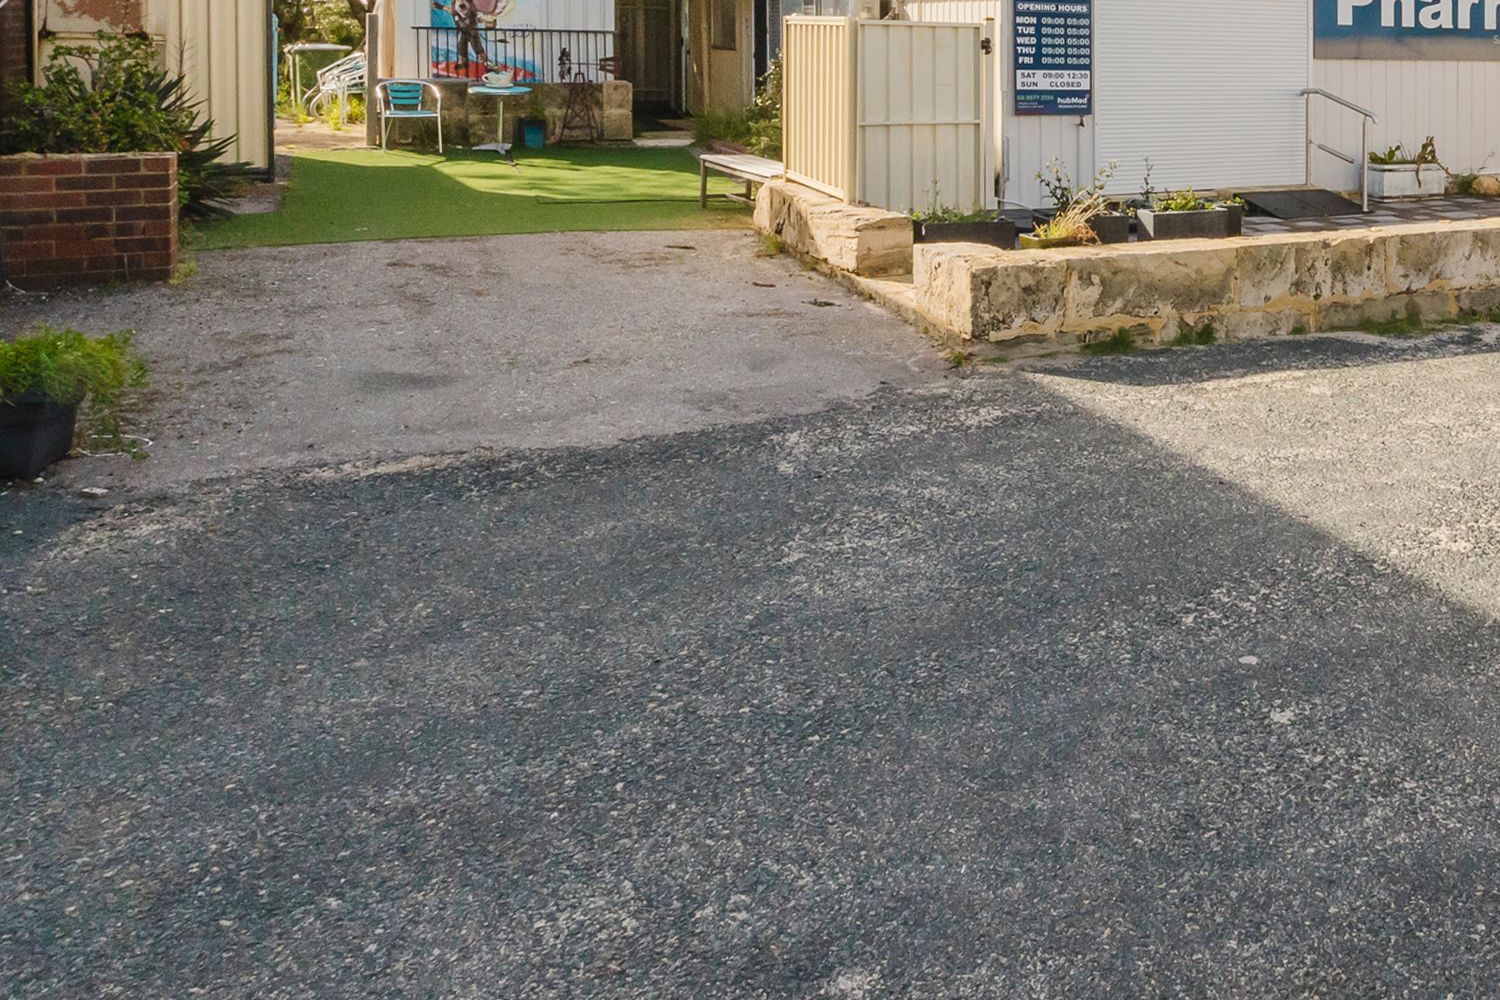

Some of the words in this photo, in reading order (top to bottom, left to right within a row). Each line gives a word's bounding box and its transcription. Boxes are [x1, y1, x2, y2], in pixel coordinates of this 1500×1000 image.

[1017, 3, 1056, 11] OPENING
[1016, 16, 1037, 24] MON
[1041, 17, 1065, 25] 09:00
[1016, 26, 1036, 34] TUE
[1041, 27, 1065, 35] 09:00
[1041, 37, 1065, 45] 09:00
[1067, 38, 1090, 46] 05:00
[1016, 46, 1036, 54] THU
[1042, 47, 1065, 55] 09:00
[1067, 48, 1090, 56] 05:00
[1018, 56, 1034, 64] FRI
[1041, 57, 1065, 65] 09:00
[1067, 57, 1090, 65] 05:00
[1067, 72, 1088, 80] 12:30
[1057, 96, 1088, 104] hubMed
